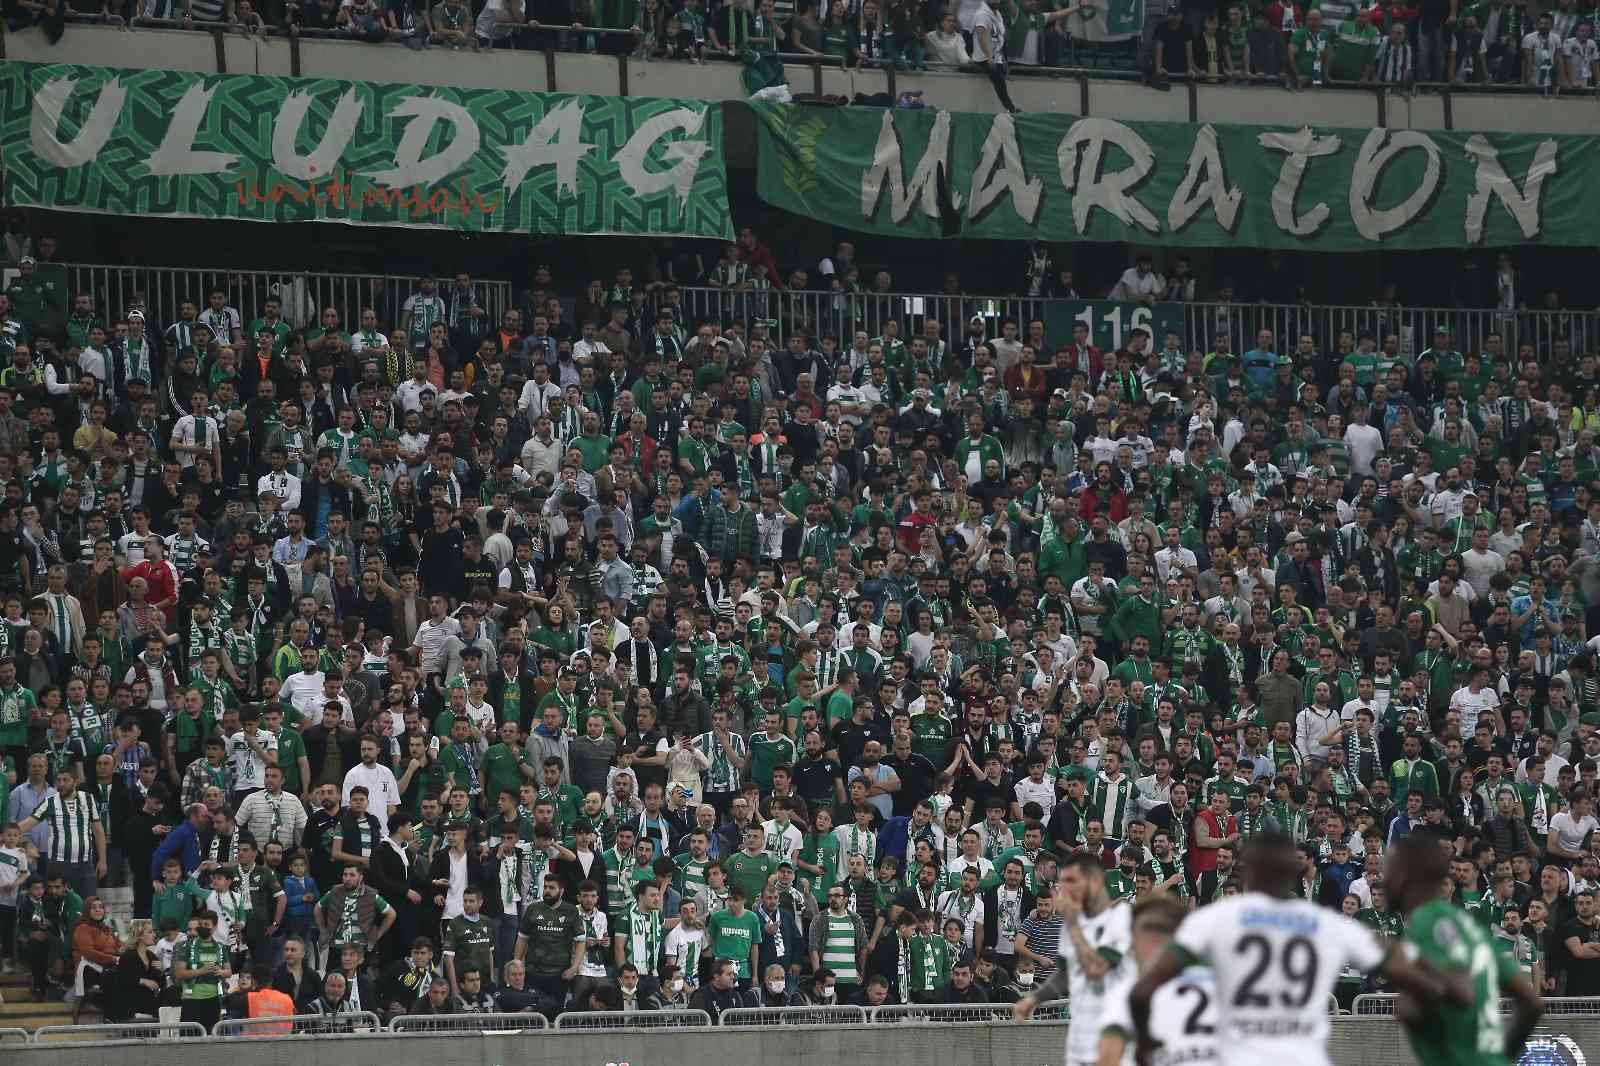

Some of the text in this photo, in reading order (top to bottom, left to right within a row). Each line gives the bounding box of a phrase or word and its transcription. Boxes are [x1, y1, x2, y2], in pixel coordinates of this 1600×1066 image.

[30, 74, 710, 218] ULUDAG
[861, 109, 1558, 243] MARATON
[1075, 305, 1154, 356] 116
[1232, 932, 1319, 1009] 29
